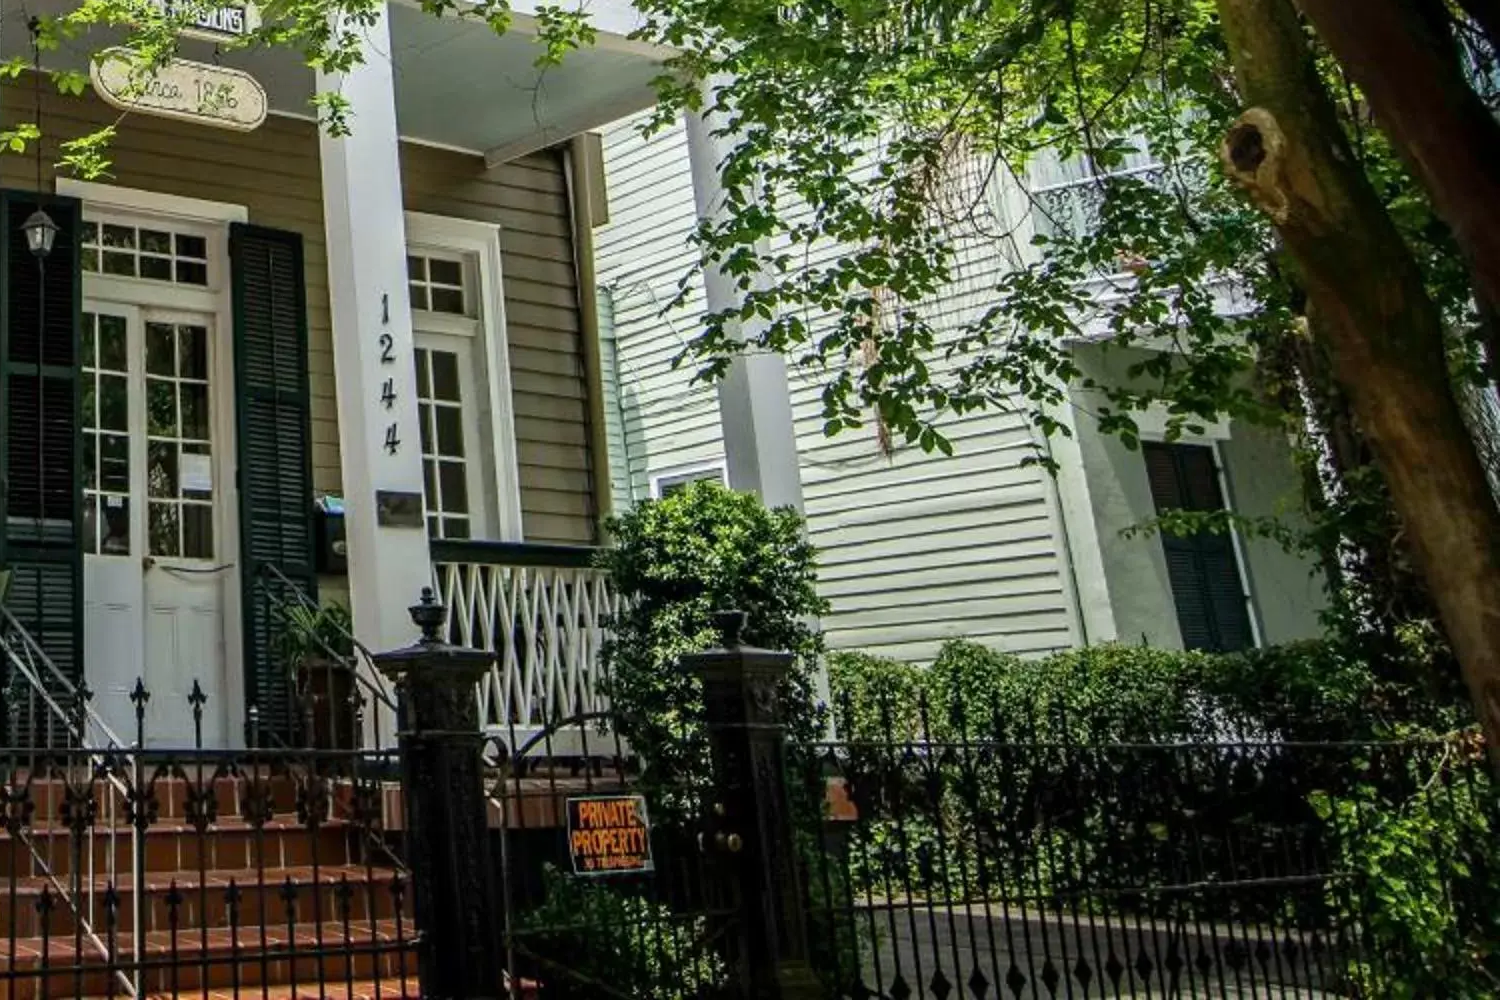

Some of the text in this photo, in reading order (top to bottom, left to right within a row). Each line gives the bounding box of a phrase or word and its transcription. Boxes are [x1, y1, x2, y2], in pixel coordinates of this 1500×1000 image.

[379, 293, 401, 456] 1244
[578, 800, 638, 828] PRIVATE
[571, 827, 645, 856] PROPERTY
